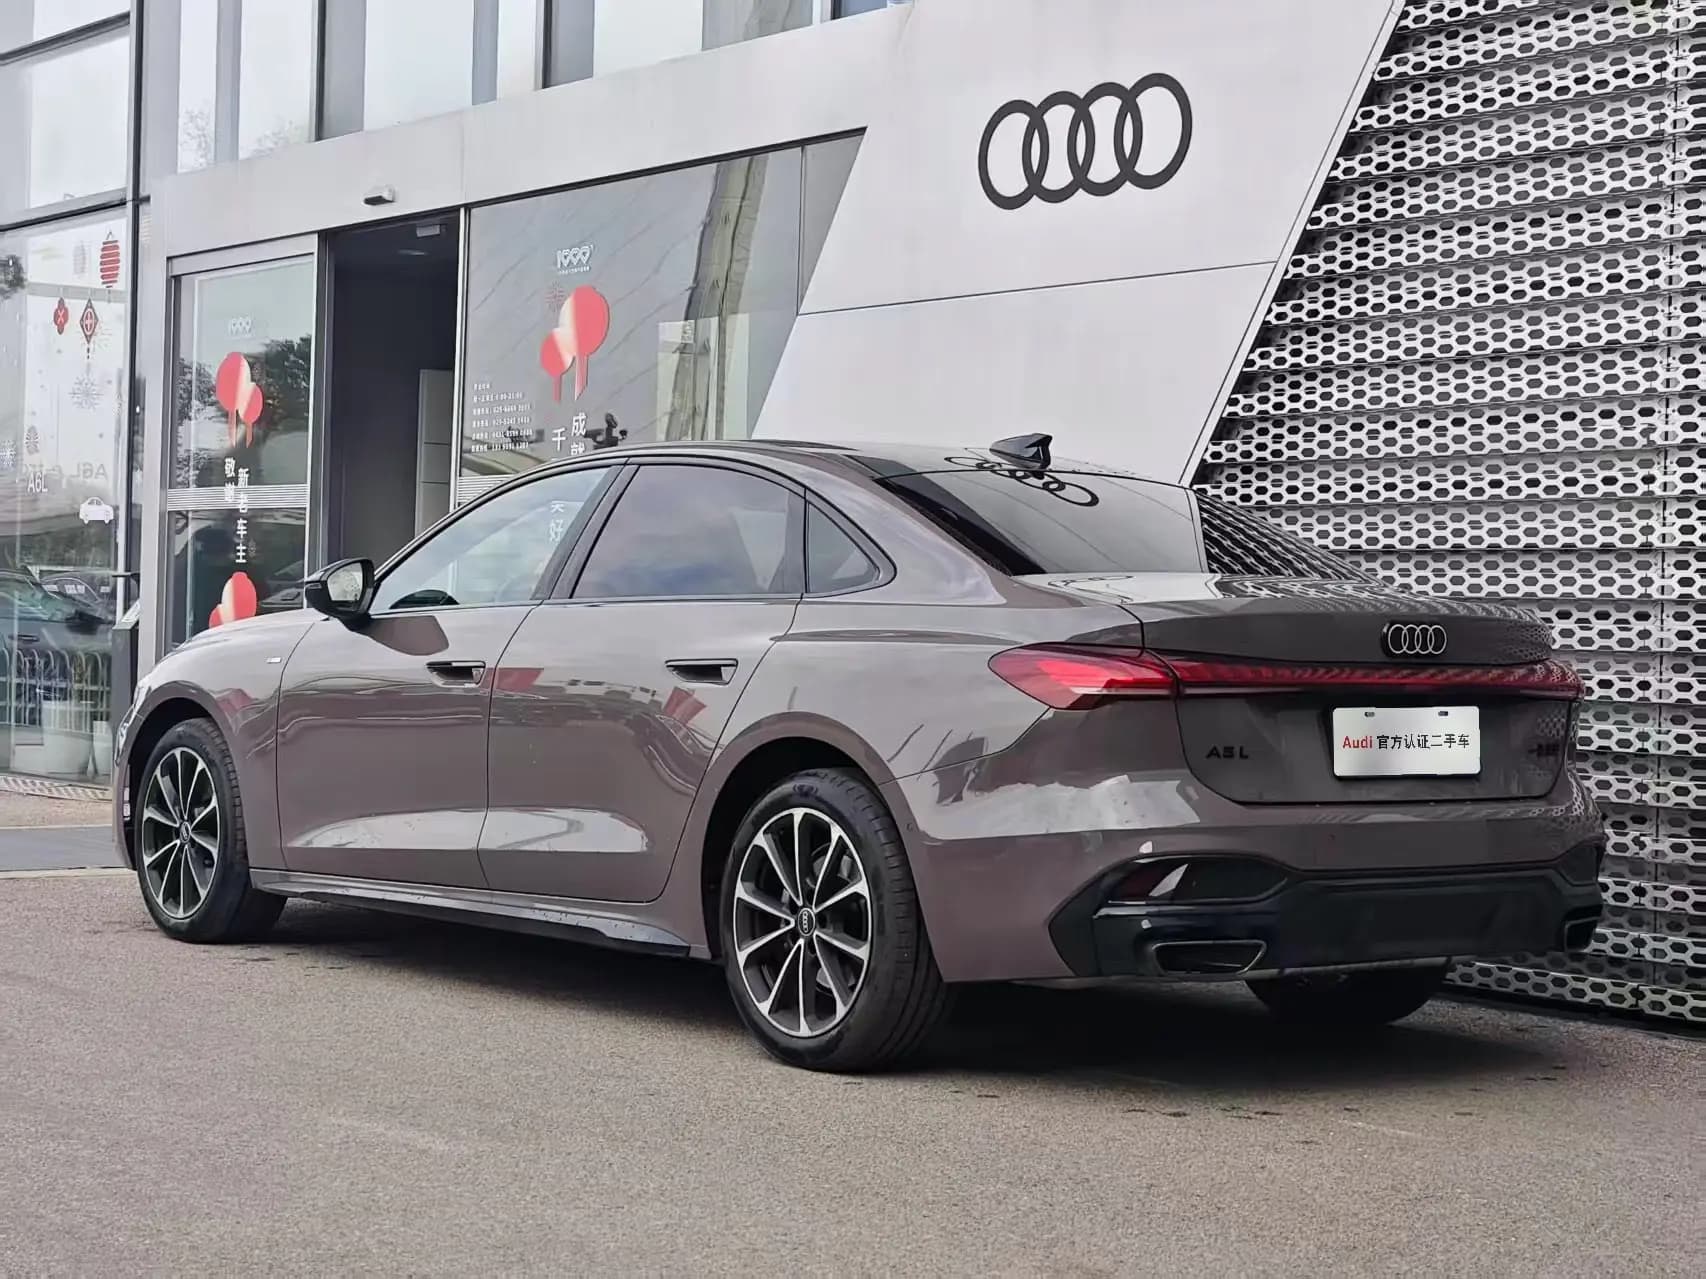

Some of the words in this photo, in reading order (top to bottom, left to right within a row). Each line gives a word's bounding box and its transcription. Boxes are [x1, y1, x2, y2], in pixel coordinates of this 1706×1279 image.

[27, 472, 48, 493] A6L
[1342, 735, 1373, 749] Audi
[1376, 734, 1470, 750] 官方认证二手车
